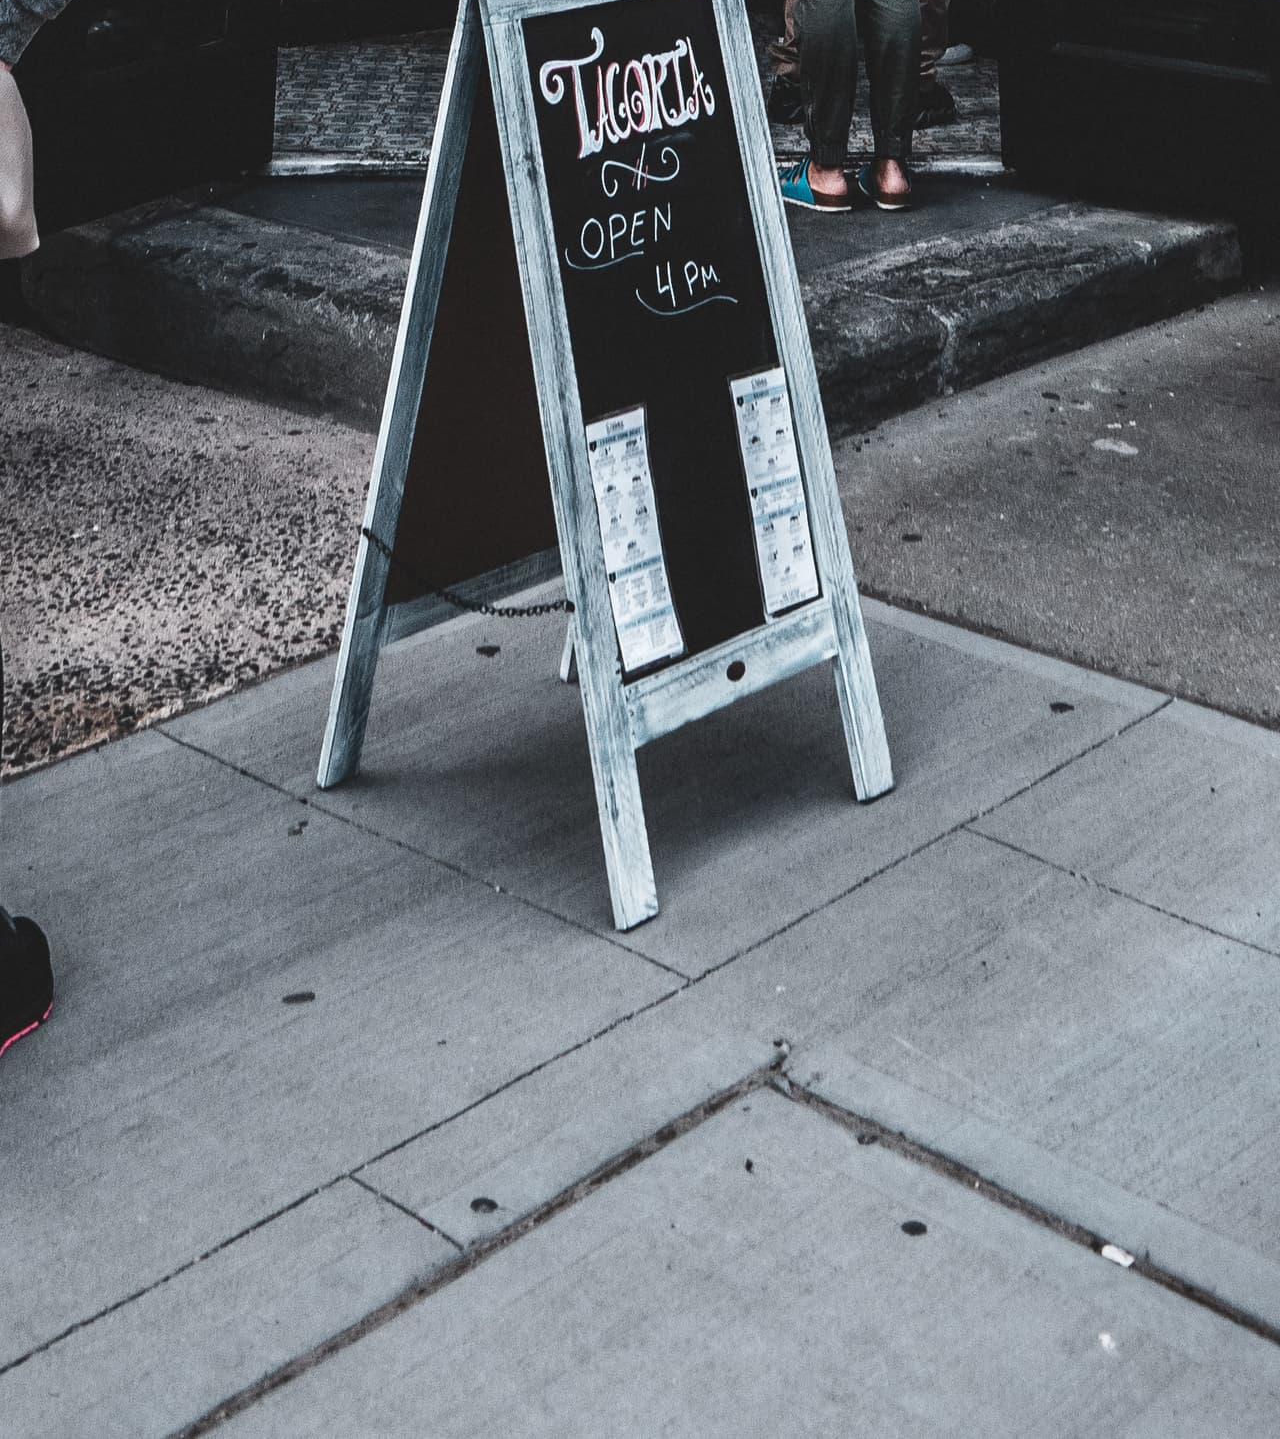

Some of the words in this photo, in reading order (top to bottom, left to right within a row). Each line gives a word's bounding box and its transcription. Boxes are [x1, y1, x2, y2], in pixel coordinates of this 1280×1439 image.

[539, 26, 715, 160] TACORIA
[580, 202, 671, 259] OPEN
[656, 261, 676, 307] 4
